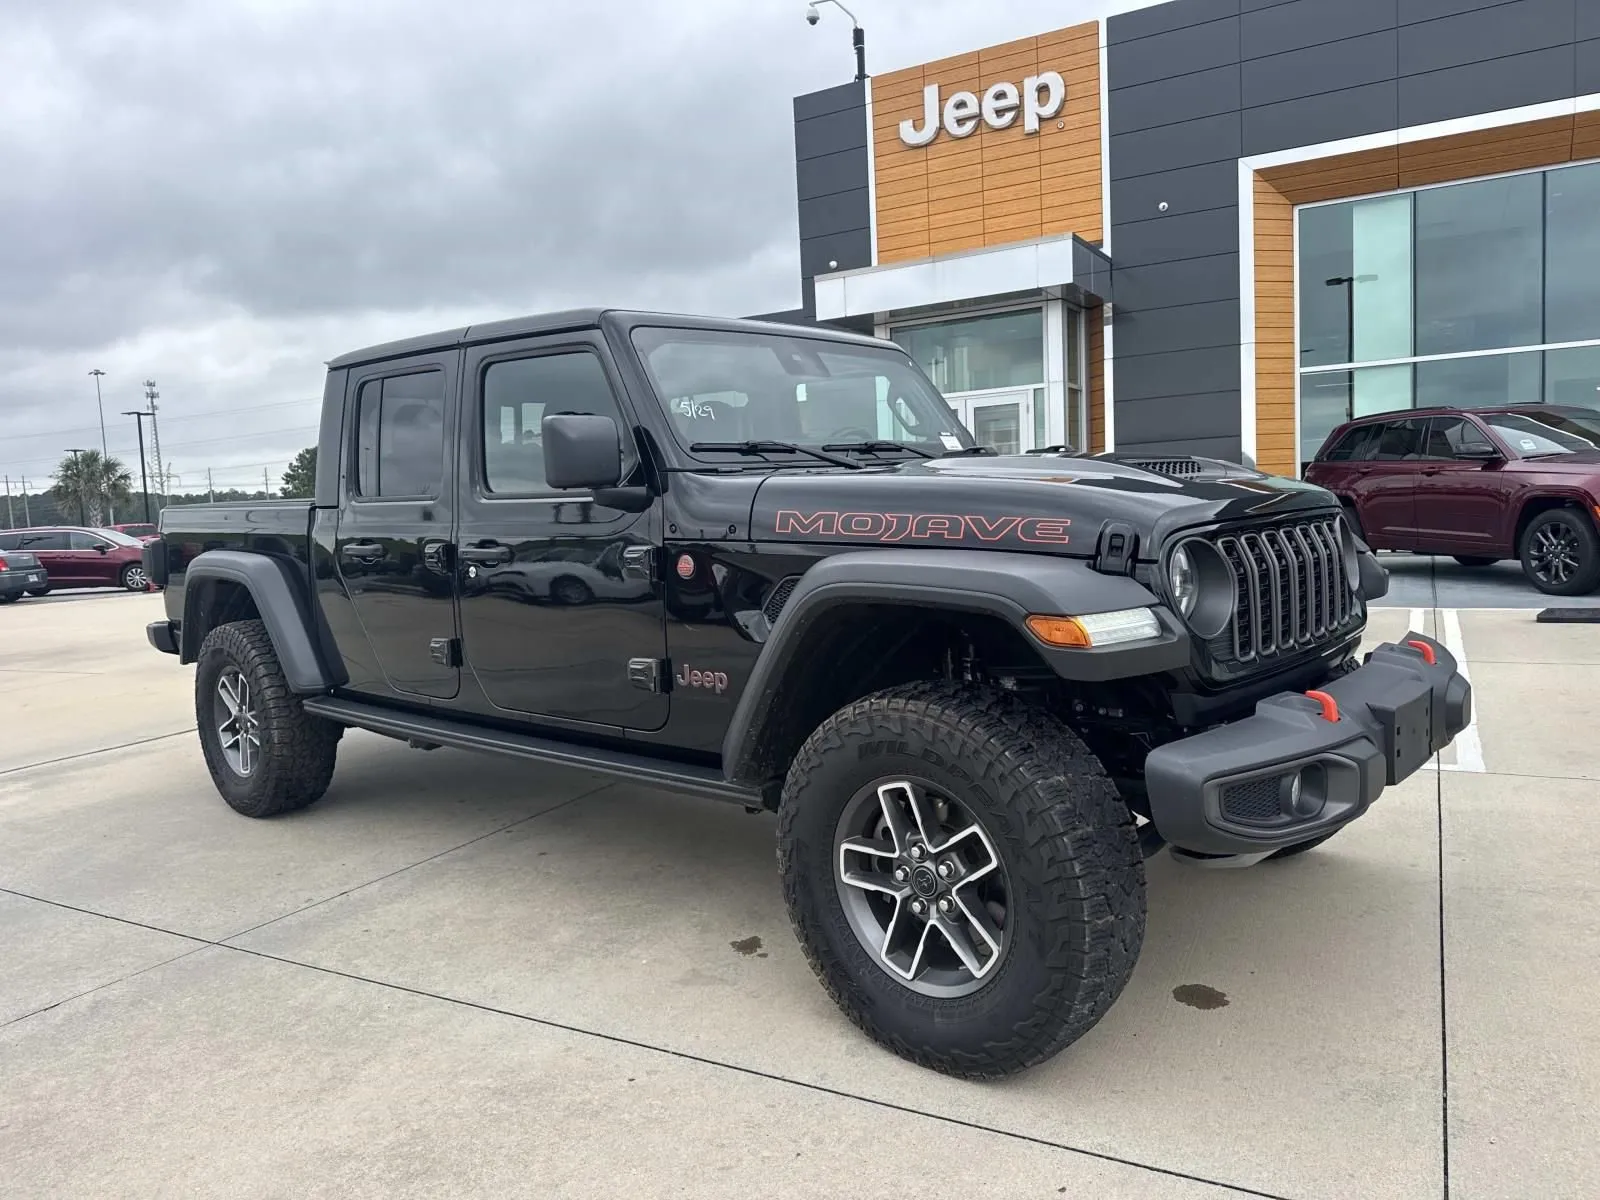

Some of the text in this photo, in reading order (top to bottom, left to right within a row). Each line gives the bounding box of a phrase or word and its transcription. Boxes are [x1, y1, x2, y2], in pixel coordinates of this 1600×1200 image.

[899, 71, 1066, 147] Jeep
[679, 399, 716, 421] 5/29
[775, 510, 1071, 544] MOJAVE
[676, 664, 729, 694] Jeep
